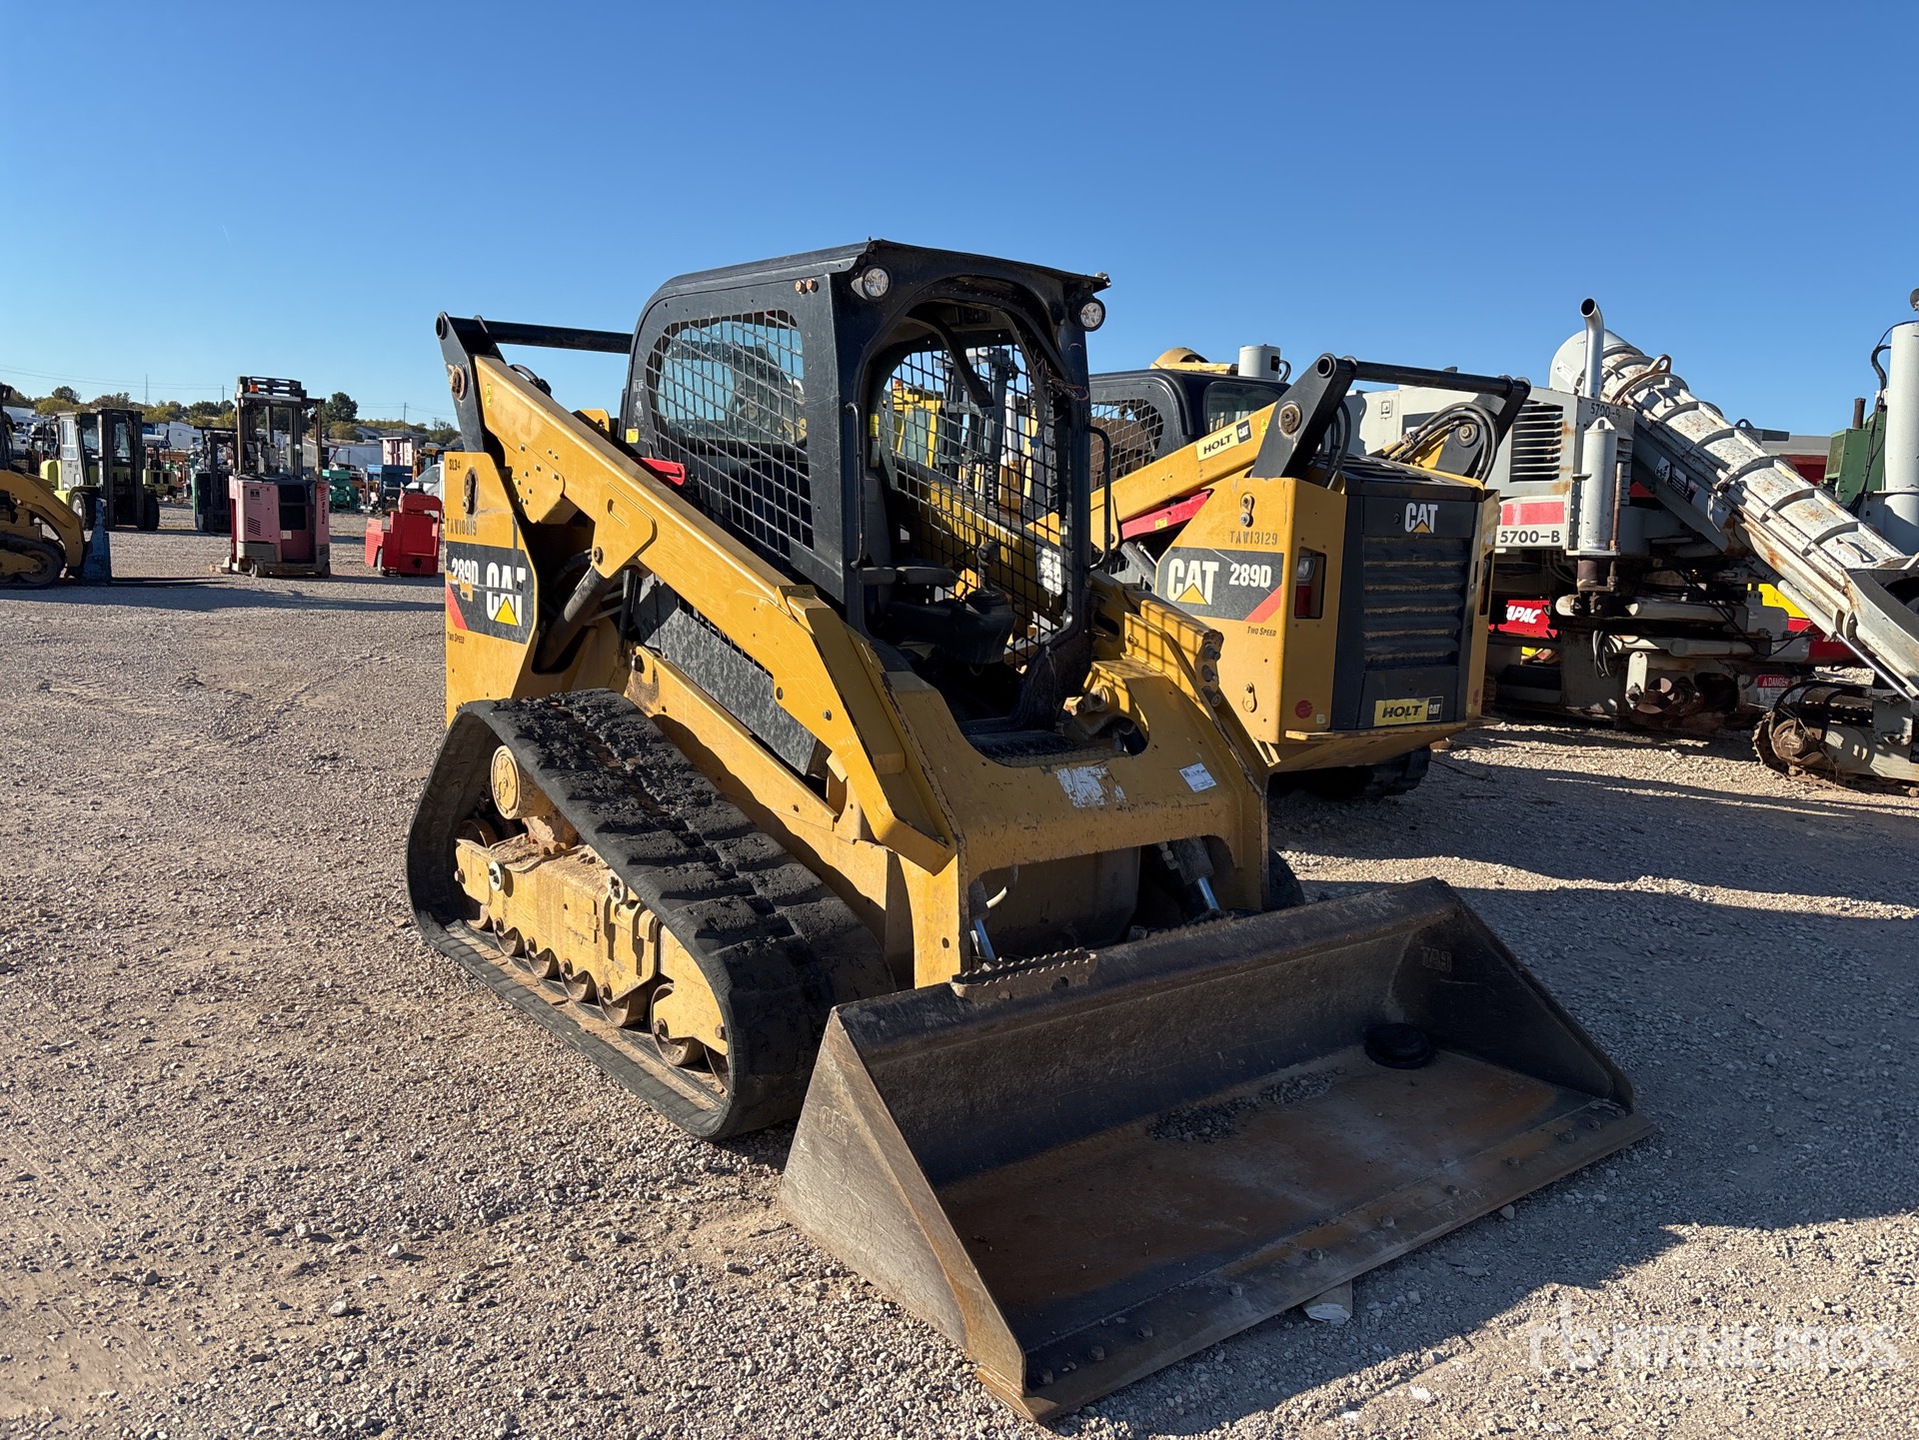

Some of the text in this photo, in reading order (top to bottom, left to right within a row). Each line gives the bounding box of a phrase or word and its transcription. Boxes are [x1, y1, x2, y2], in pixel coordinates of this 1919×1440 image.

[1203, 425, 1249, 455] HOLT CAT
[1404, 502, 1438, 533] CAT
[1230, 531, 1278, 545] TAW13129
[1500, 531, 1561, 544] 5700-B
[451, 557, 526, 627] 289D CAT
[1166, 558, 1272, 605] CAT 289D
[1382, 704, 1441, 718] HOLT CAT
